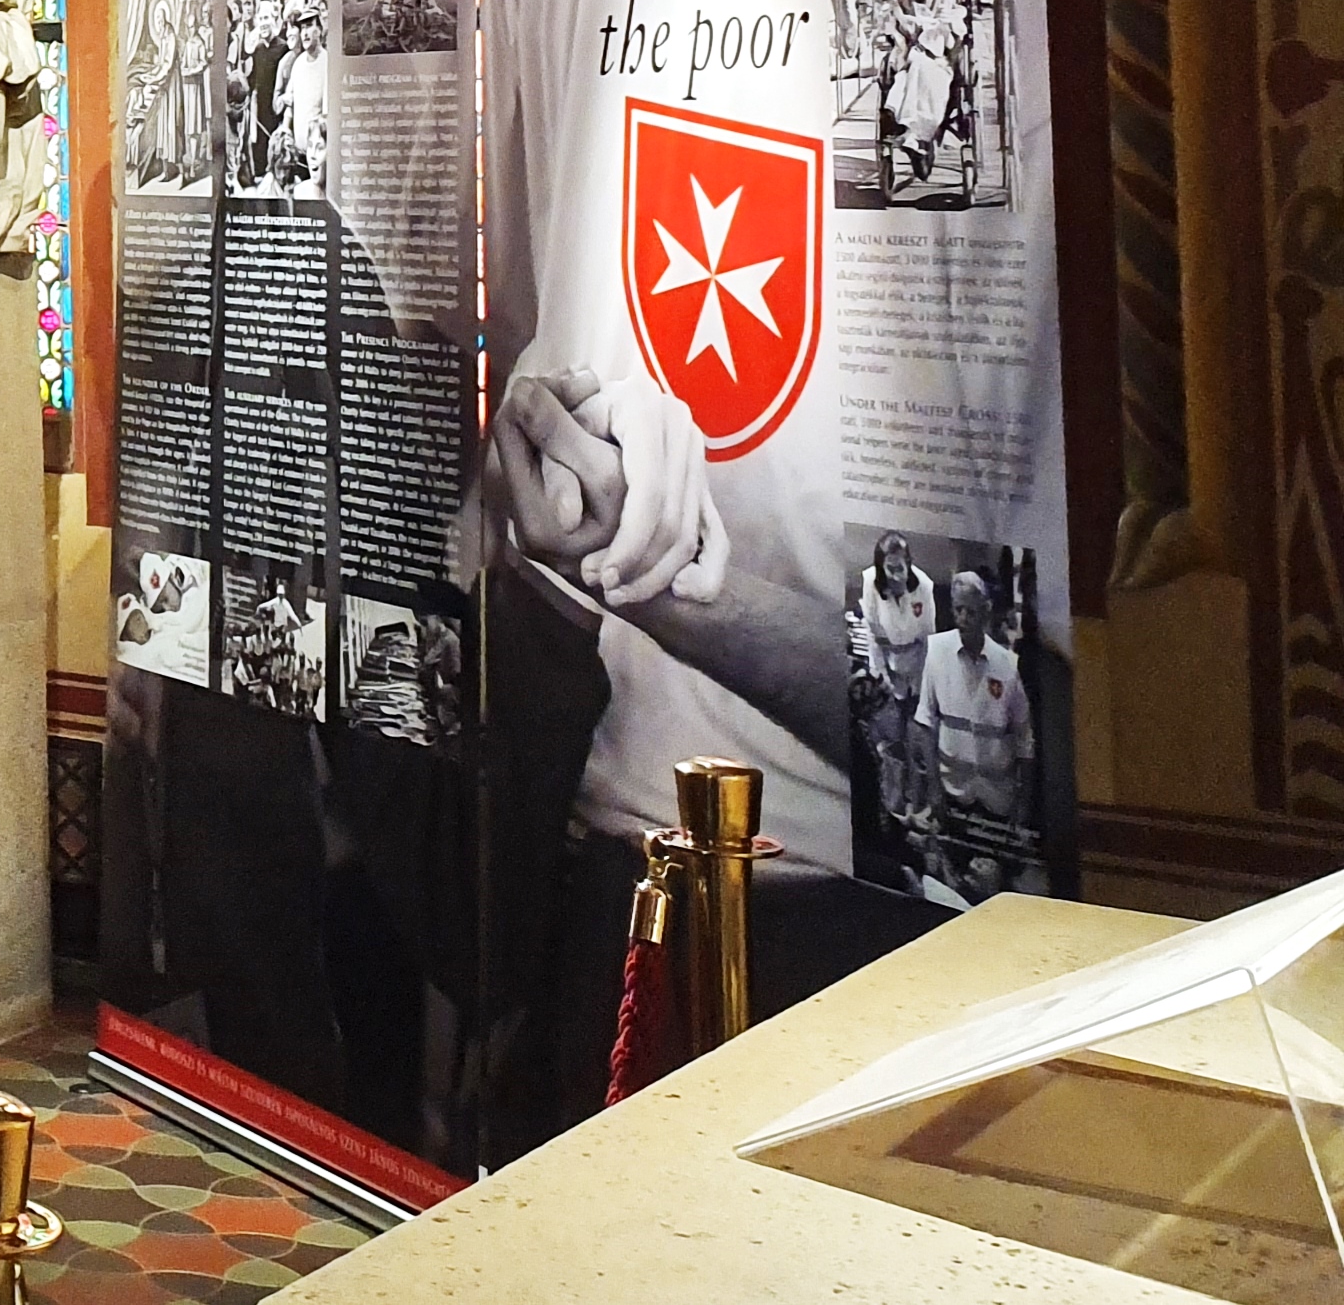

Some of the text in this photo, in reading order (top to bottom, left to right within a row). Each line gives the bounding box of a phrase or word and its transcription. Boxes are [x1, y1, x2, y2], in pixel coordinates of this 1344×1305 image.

[682, 8, 810, 100] poor
[839, 394, 876, 410] UNDER
[880, 400, 899, 413] THE
